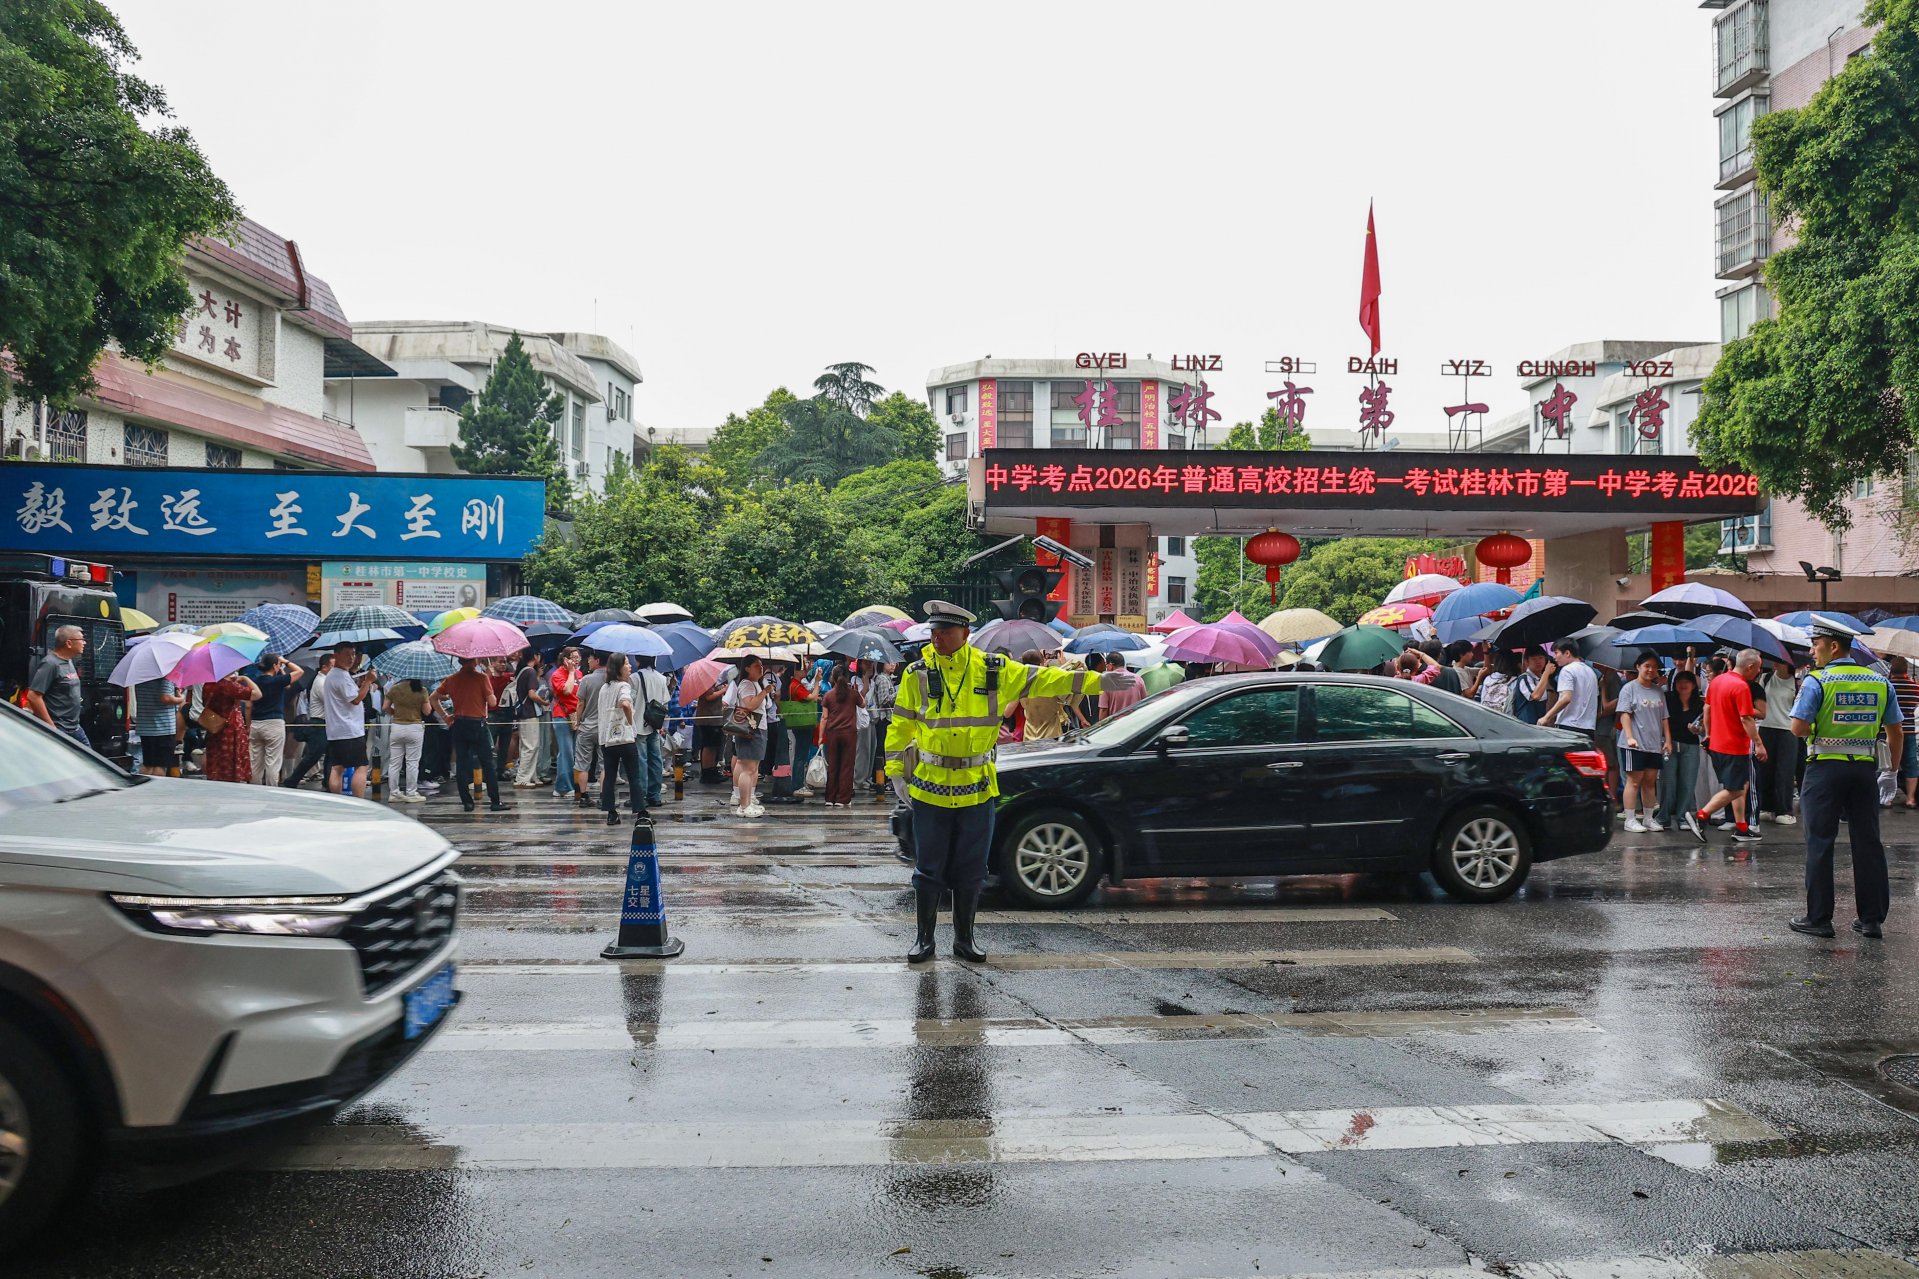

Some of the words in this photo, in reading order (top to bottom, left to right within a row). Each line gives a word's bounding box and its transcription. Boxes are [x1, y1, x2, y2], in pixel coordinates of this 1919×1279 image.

[198, 289, 243, 329] 大计
[1076, 352, 1127, 369] GVEI
[1173, 354, 1222, 370] LINZ
[1280, 356, 1301, 372] SI
[1349, 356, 1398, 374] DAIH
[1449, 359, 1486, 375] YIZ
[1519, 360, 1596, 376] CUNGH
[1629, 360, 1674, 376] YOZ
[981, 383, 994, 417] 弘毅致远
[1071, 378, 1671, 440] 桂林市第一中学
[981, 420, 994, 449] 至大至
[1143, 422, 1156, 449] 五育并
[986, 464, 1759, 498] 中学考点2026年普通高校招生统一考试桂林市第一中学考点2026
[355, 565, 468, 579] 桂林市第一中学校史
[1838, 694, 1875, 704] 桂林交警
[627, 885, 650, 896] 七星
[627, 896, 650, 908] 交警
